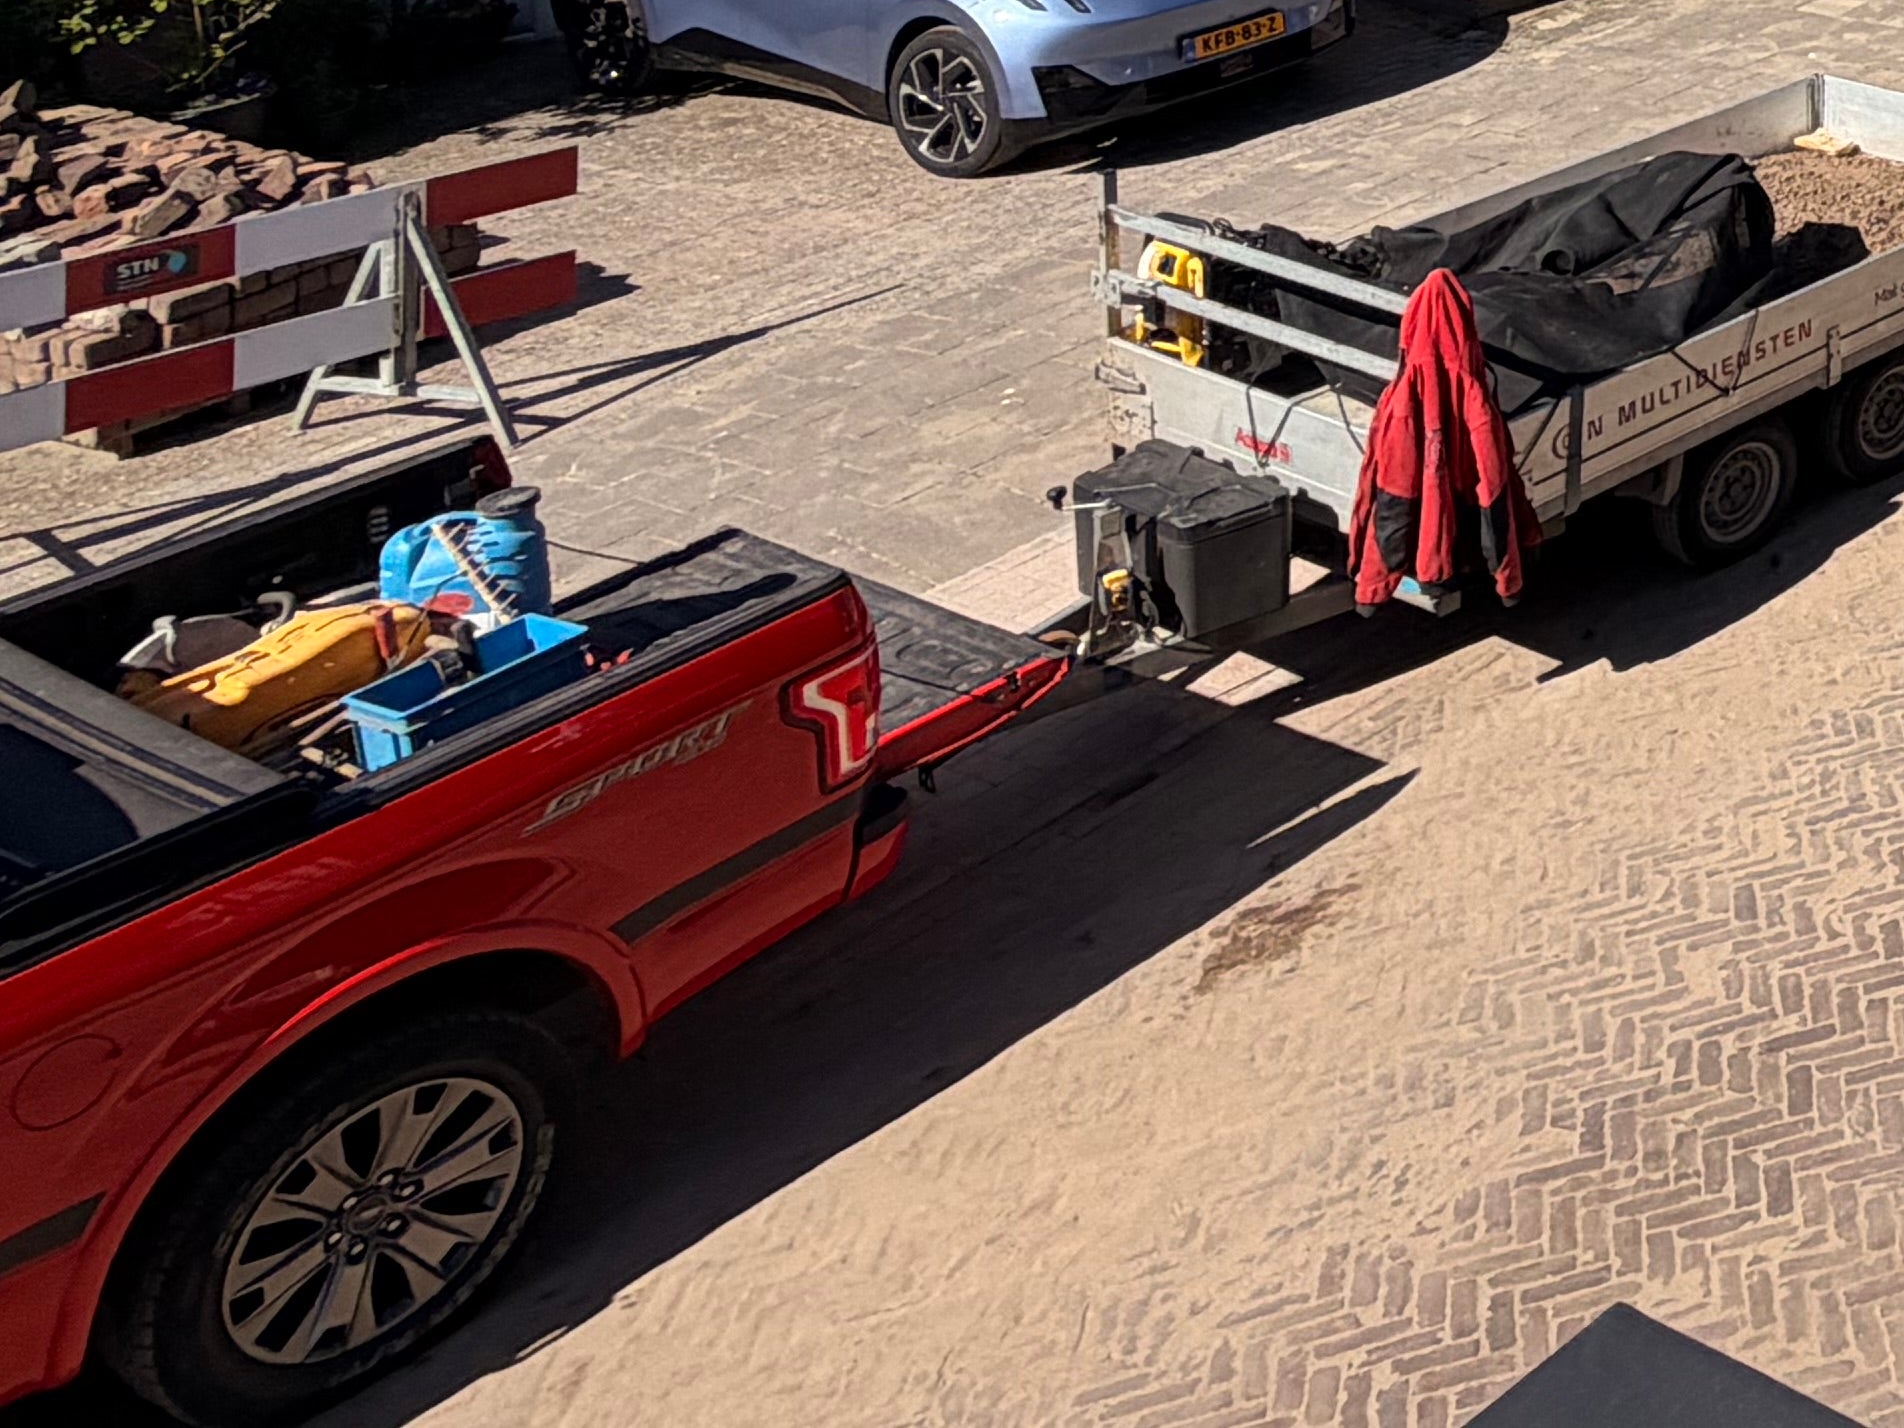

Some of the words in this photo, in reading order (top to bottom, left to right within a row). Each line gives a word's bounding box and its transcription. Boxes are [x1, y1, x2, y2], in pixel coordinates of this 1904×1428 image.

[116, 256, 160, 279] STN
[1617, 319, 1812, 427] MULTIDIENSTEN
[521, 698, 753, 838] SPORT
